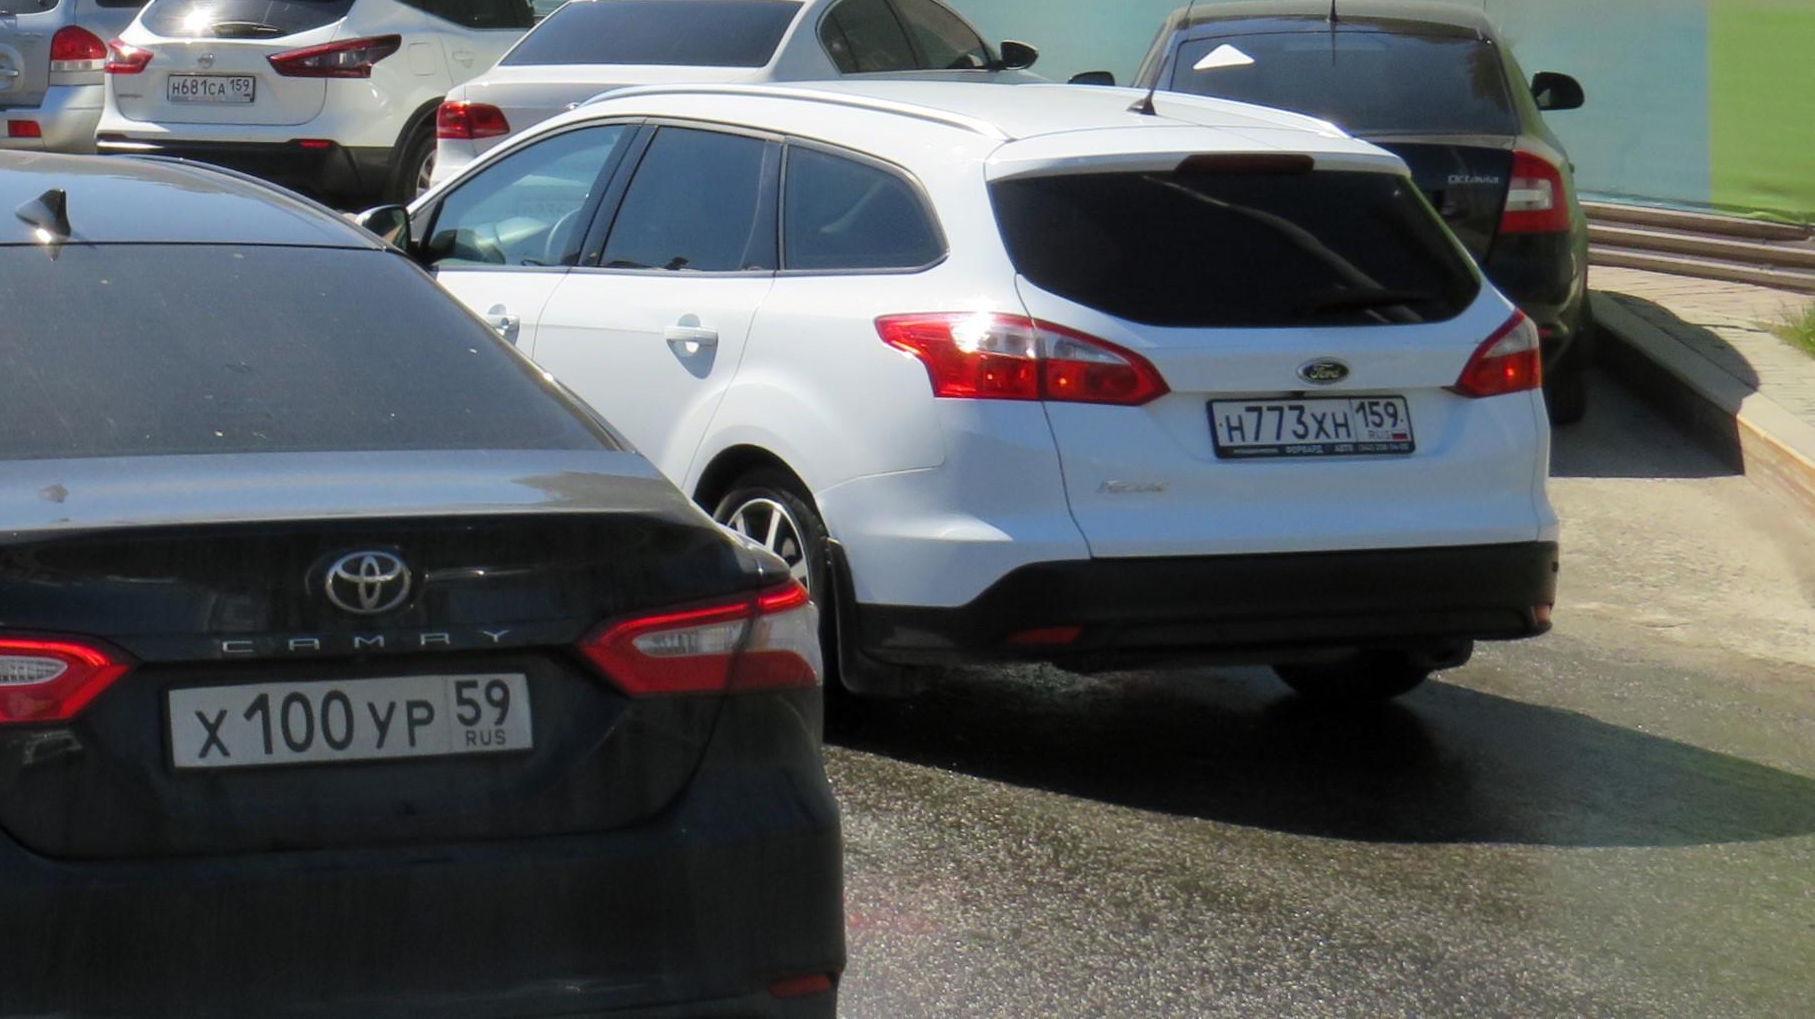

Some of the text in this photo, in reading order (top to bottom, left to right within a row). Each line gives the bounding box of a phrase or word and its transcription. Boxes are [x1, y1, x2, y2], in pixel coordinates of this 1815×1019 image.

[1309, 363, 1341, 379] Ford
[1225, 401, 1399, 443] Н773ХН 159
[222, 629, 510, 654] CAMRY
[194, 679, 511, 759] Х100УР 59
[465, 729, 507, 747] RUS
